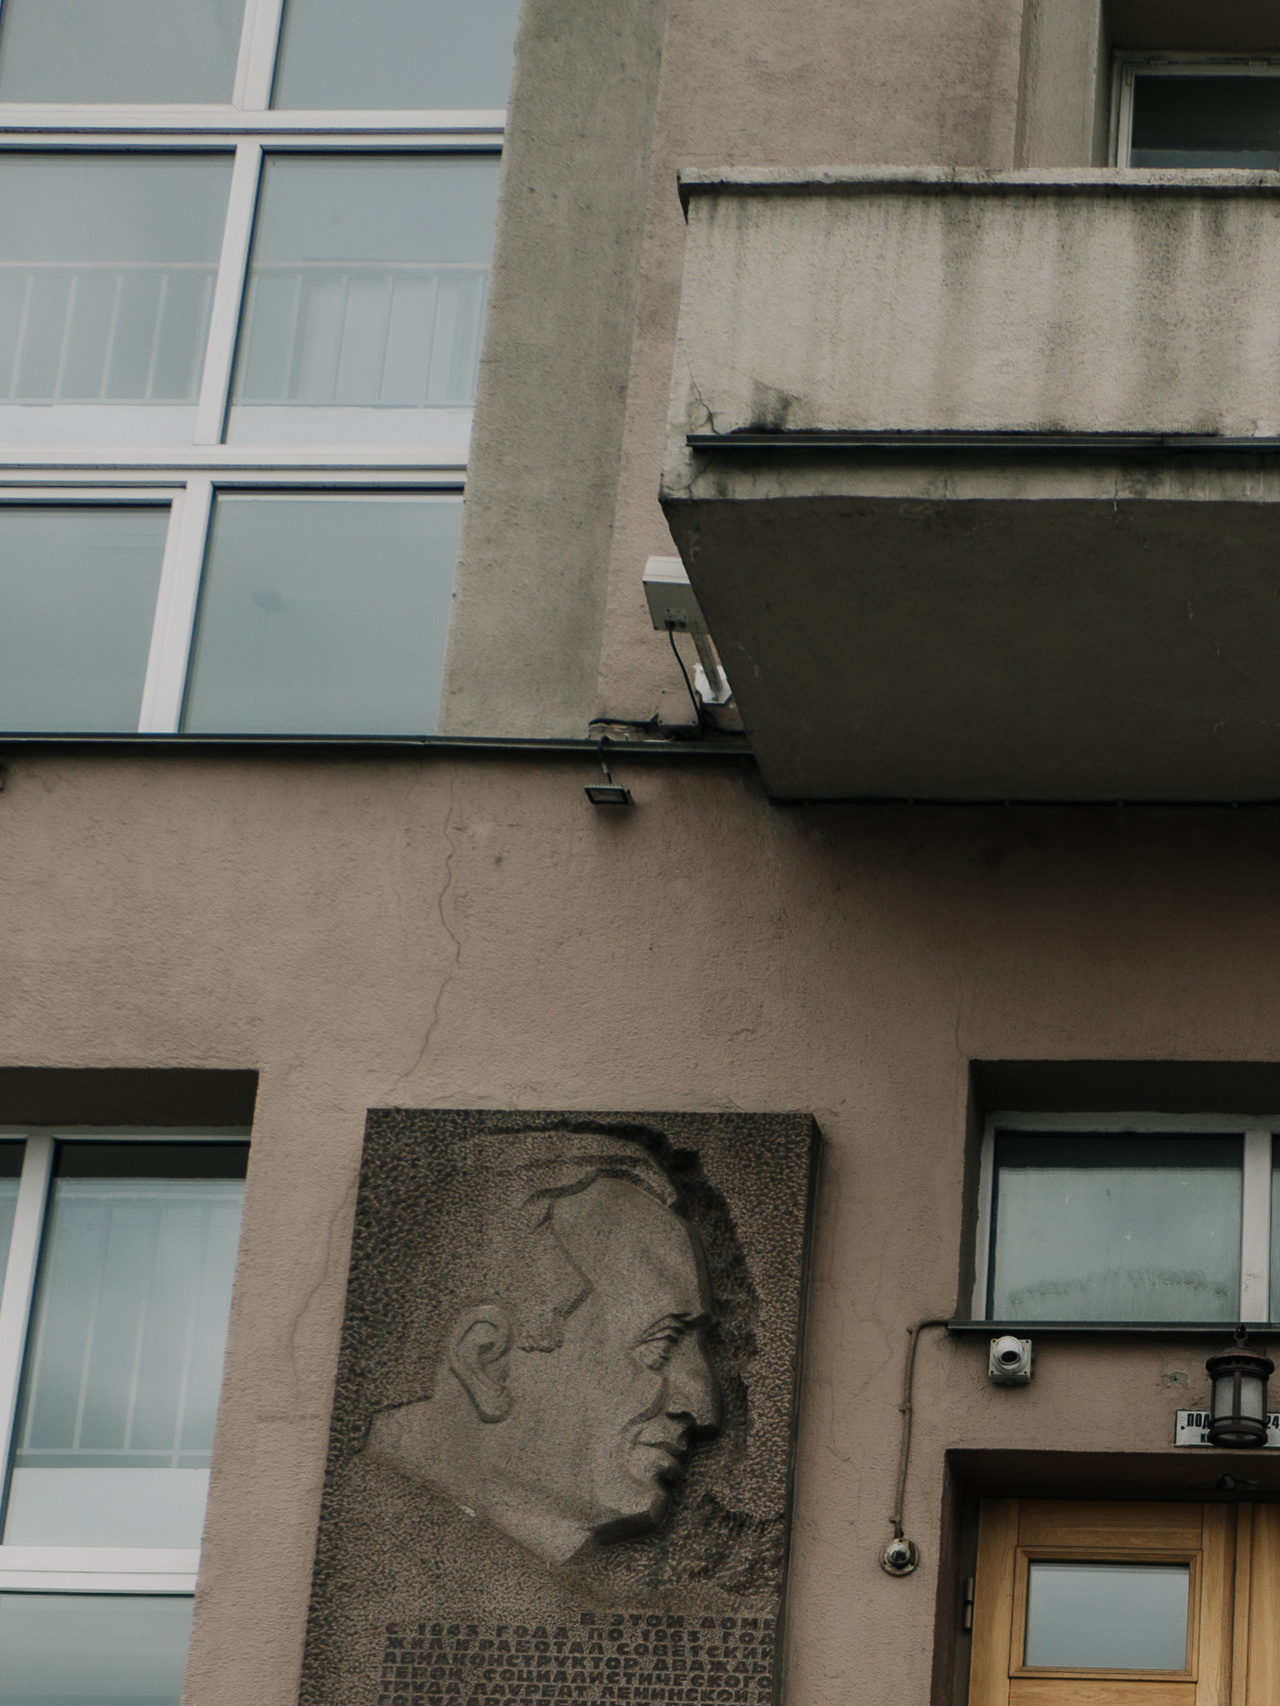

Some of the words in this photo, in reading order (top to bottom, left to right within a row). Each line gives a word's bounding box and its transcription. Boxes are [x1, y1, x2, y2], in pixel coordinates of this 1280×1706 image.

[580, 1613, 596, 1625] В
[611, 1614, 685, 1628] ЭТОМ
[701, 1616, 777, 1630] ДОМЕ
[385, 1622, 400, 1635] С
[495, 1624, 568, 1639] ГОДА
[588, 1628, 624, 1642] ПО
[722, 1631, 776, 1645] ГОД
[385, 1637, 443, 1650] ЖИЛ
[455, 1638, 470, 1651] И
[479, 1639, 604, 1655] РАБОТАЛ
[483, 1668, 773, 1688] СОЦИАЛИСТИЧЕСКОГО
[472, 1683, 588, 1698] ЛАУРЕАТ
